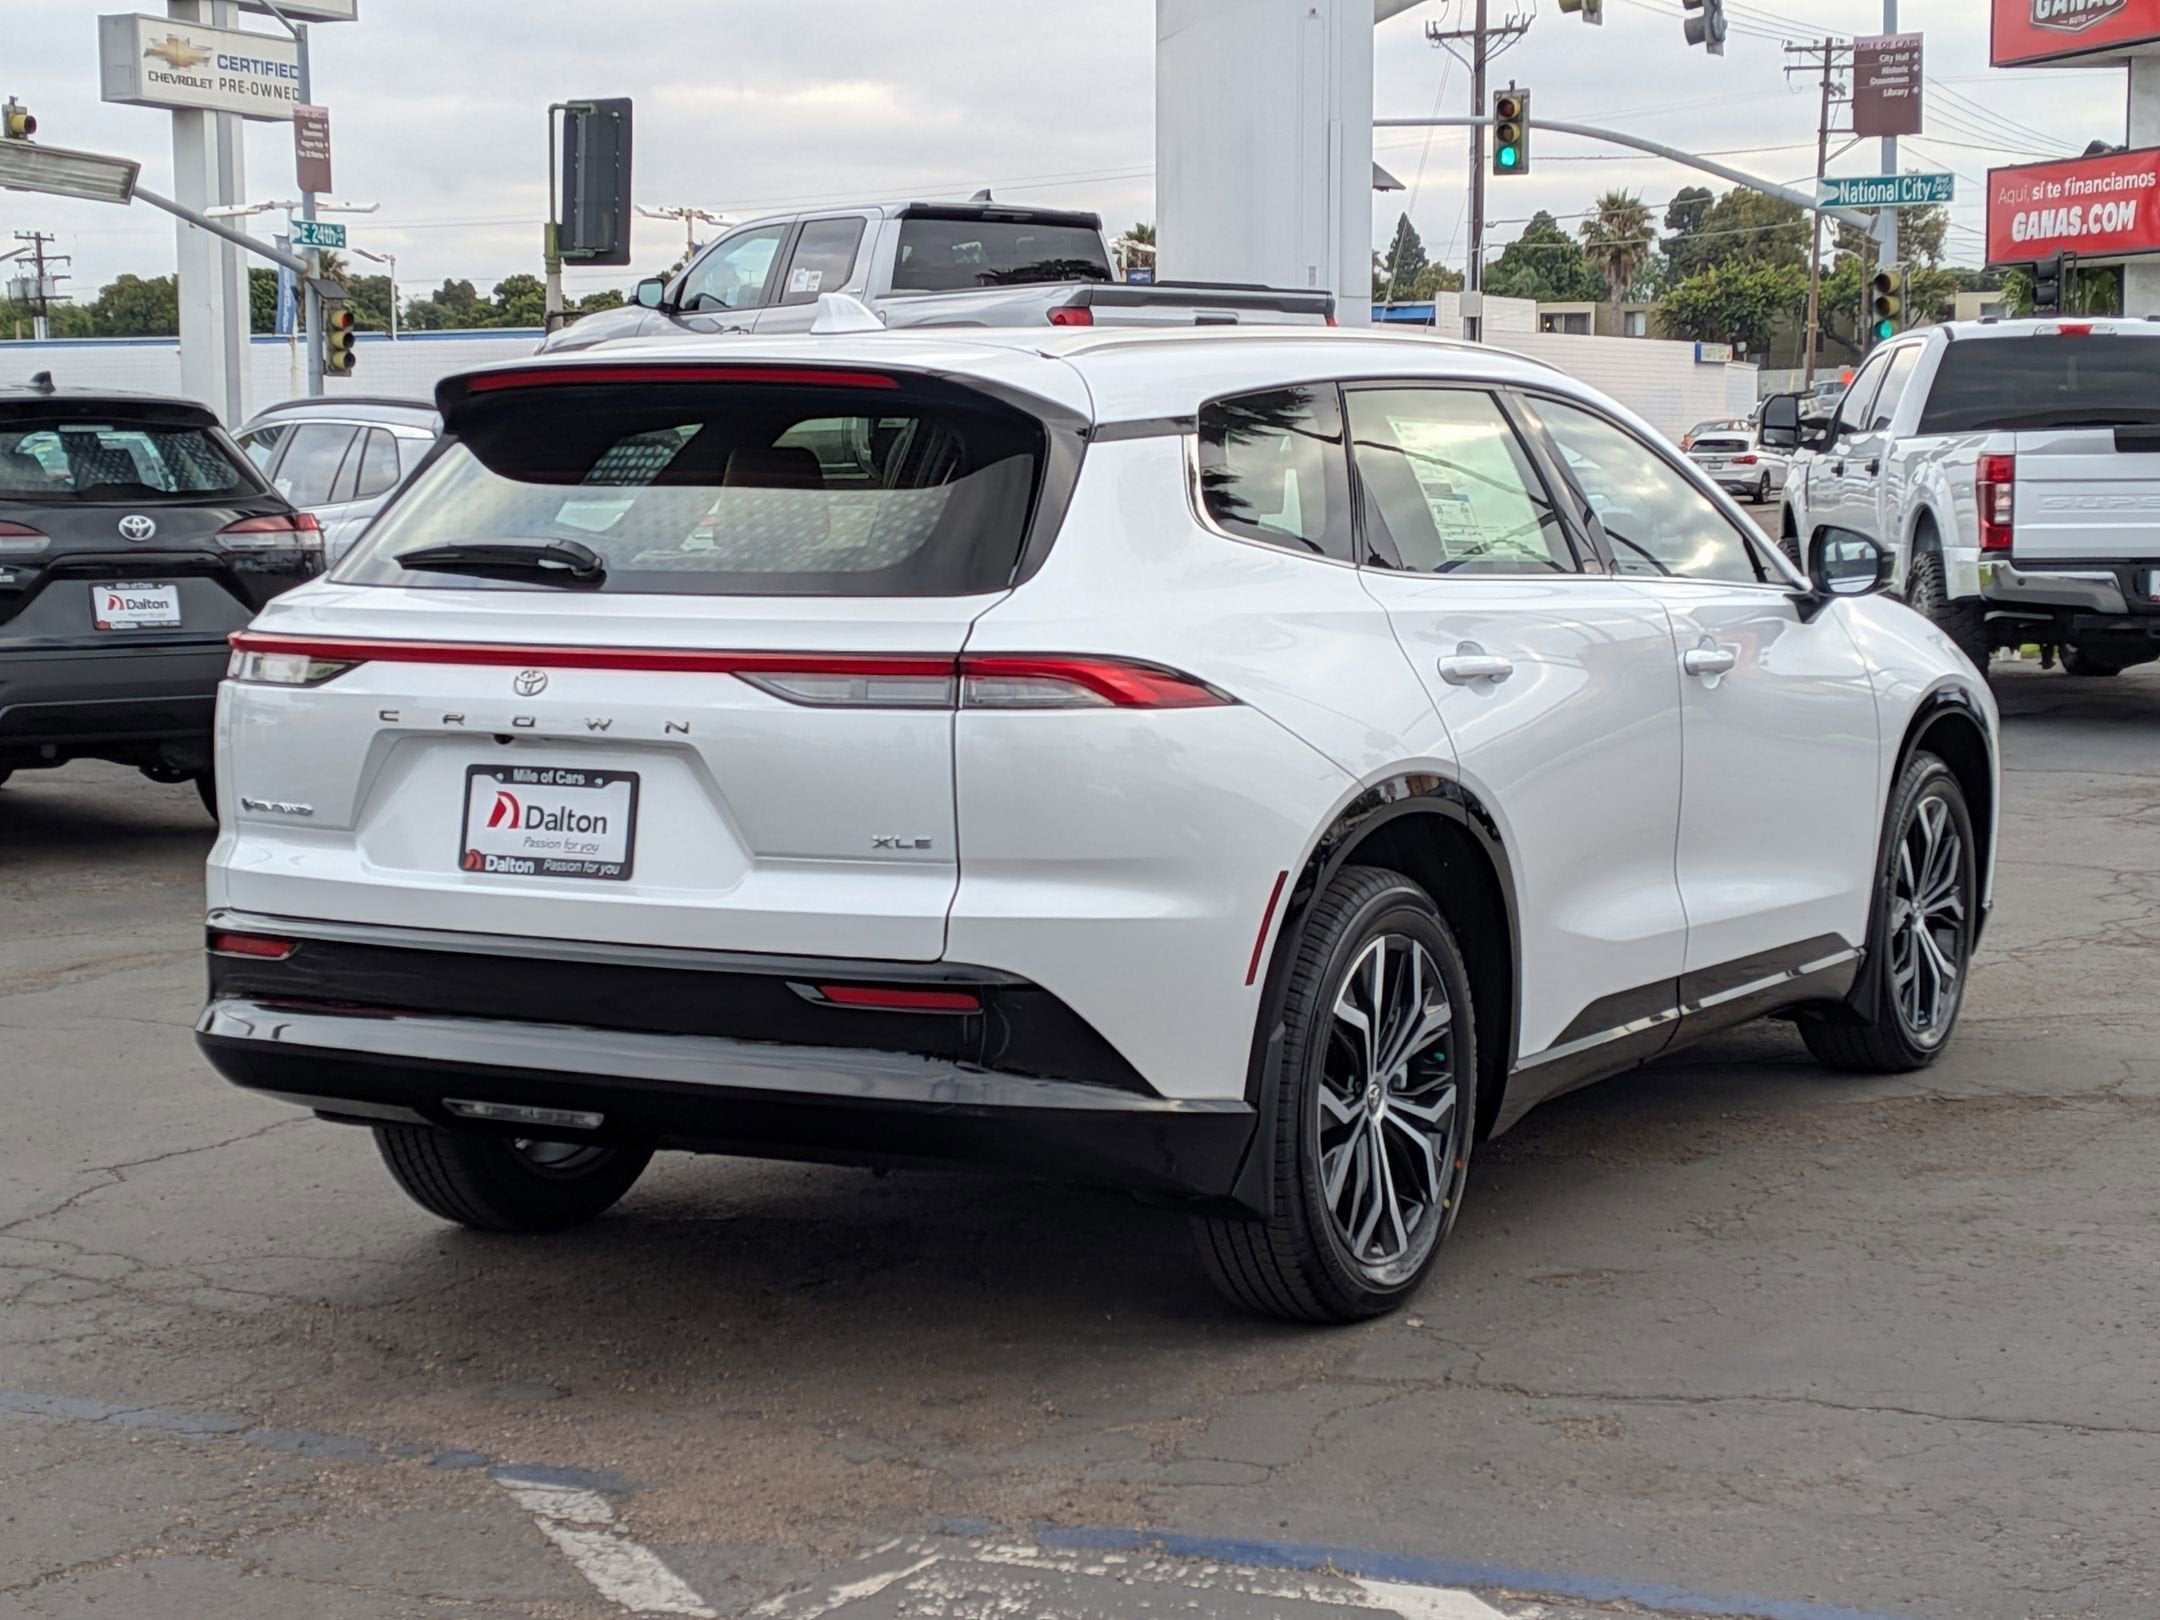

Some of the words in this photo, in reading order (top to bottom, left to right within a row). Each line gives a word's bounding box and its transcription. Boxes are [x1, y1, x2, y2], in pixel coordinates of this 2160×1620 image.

[217, 54, 299, 80] CERTIFIED
[1879, 54, 1894, 64] City
[148, 70, 213, 90] CHEVROLET
[219, 77, 299, 101] PRE-OWNED
[1882, 88, 1909, 98] Library
[1839, 179, 1899, 204] National
[1902, 177, 1932, 201] City
[2032, 181, 2045, 201] sí
[2047, 182, 2061, 198] te
[2064, 171, 2156, 197] financiamos
[2012, 200, 2137, 243] GANAS.COM
[301, 224, 310, 243] E
[311, 225, 337, 245] 24th
[126, 598, 169, 610] Dalton
[379, 709, 691, 734] CROWN
[513, 768, 538, 783] Mile
[540, 770, 554, 784] of
[555, 771, 586, 785] Cars
[525, 805, 608, 834] Dalton
[523, 836, 562, 849] Passion
[564, 838, 579, 853] for
[580, 843, 601, 853] you
[871, 834, 933, 849] XLE
[485, 855, 535, 874] Dalton
[543, 859, 582, 873] Passion
[583, 861, 598, 874] for
[598, 865, 621, 876] you
